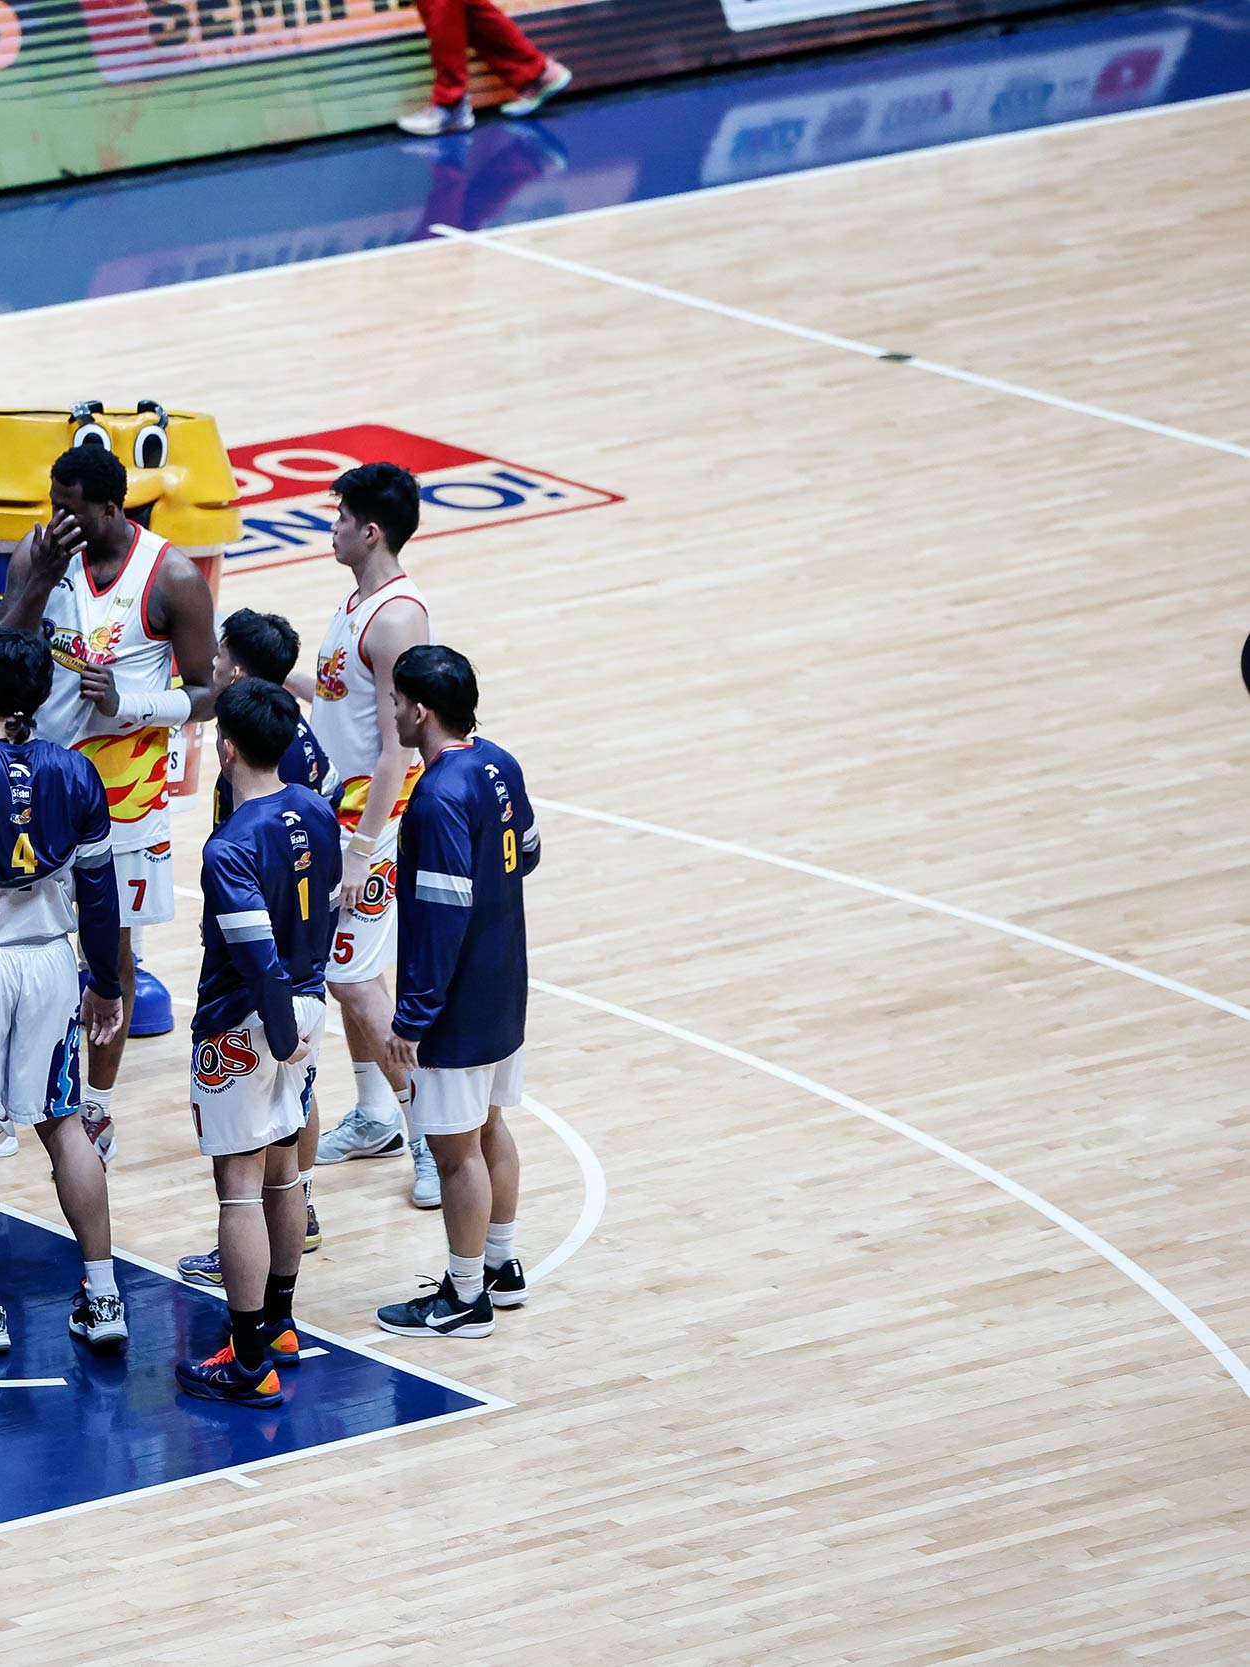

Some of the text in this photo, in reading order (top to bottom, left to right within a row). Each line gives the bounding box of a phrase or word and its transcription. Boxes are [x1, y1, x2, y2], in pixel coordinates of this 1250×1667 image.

[12, 789, 30, 799] Sista
[11, 832, 39, 875] 4
[502, 828, 518, 874] 9
[127, 879, 147, 912] 7
[297, 876, 310, 921] 1
[333, 931, 355, 965] 5
